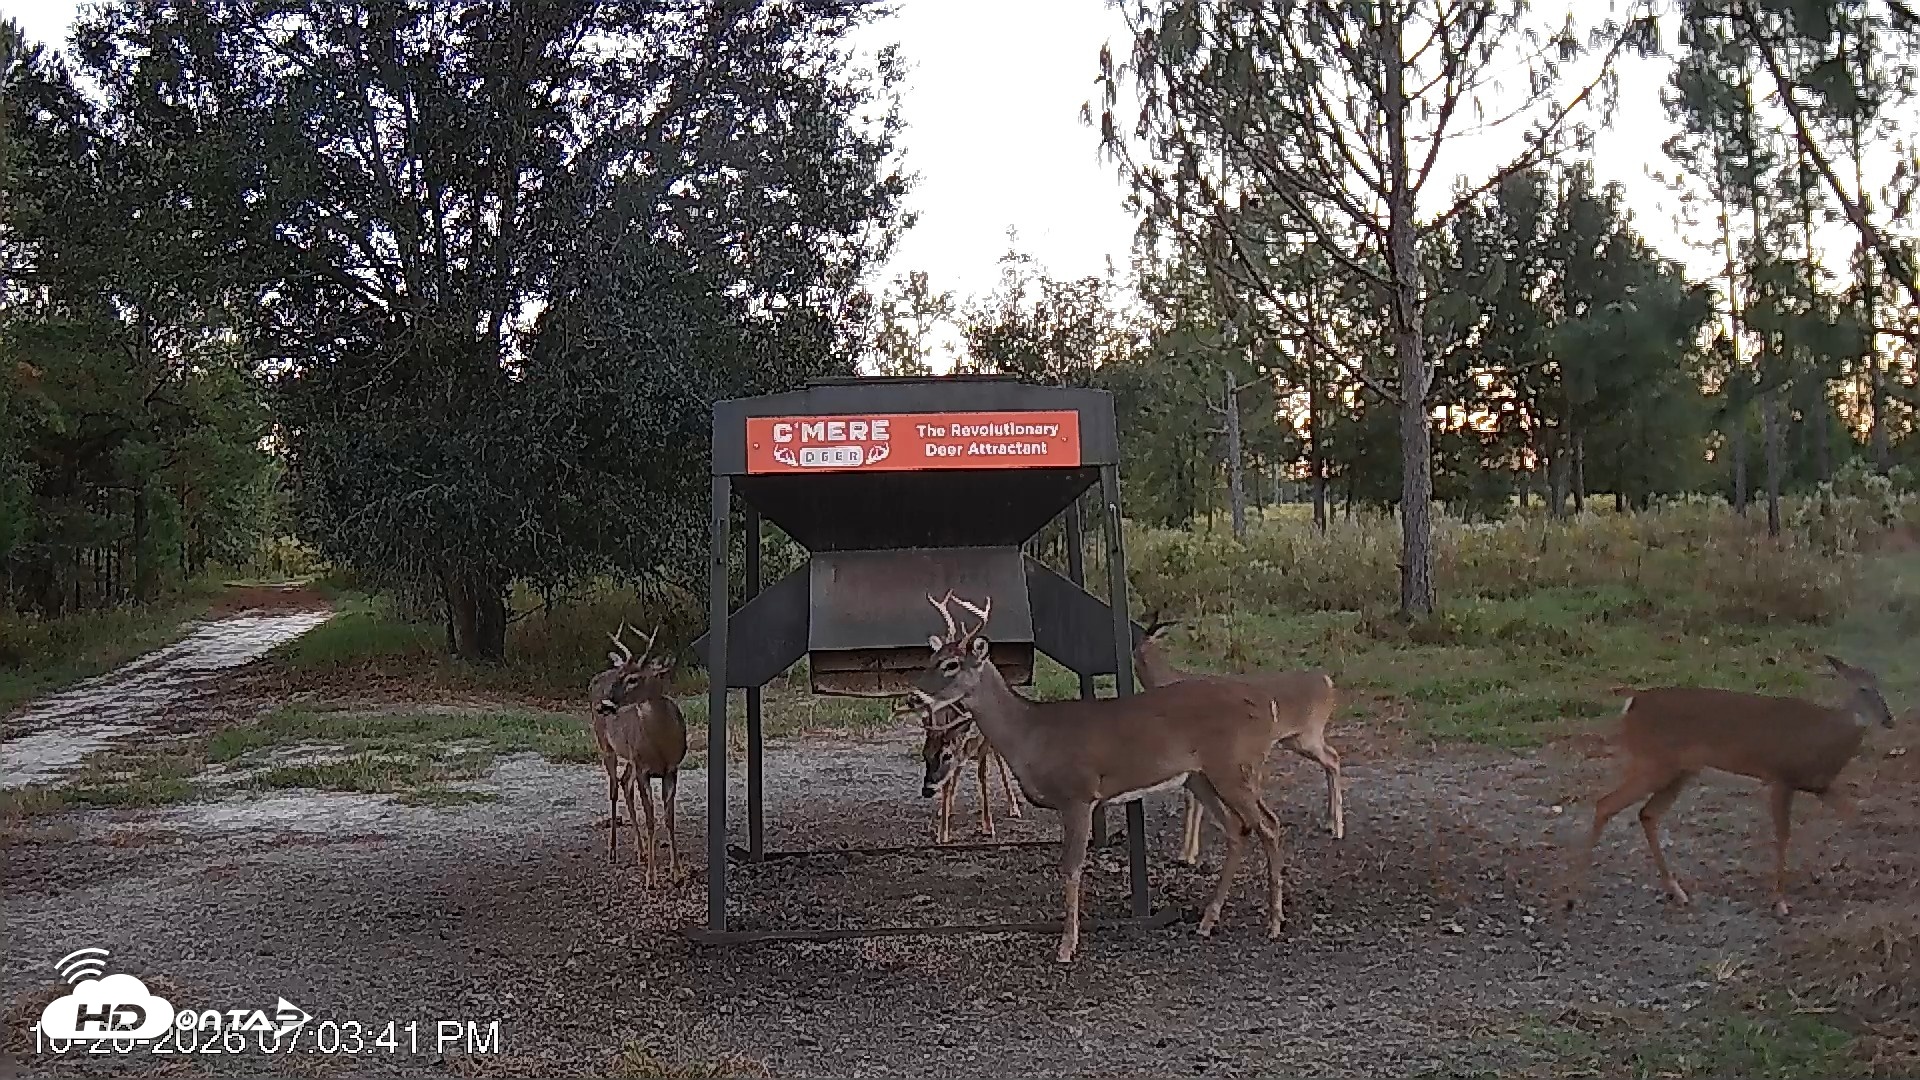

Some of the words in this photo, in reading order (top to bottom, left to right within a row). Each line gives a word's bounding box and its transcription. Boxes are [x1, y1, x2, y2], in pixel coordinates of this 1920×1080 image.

[773, 419, 890, 443] C'MERE
[916, 424, 946, 438] The
[951, 421, 1060, 438] Revolutionary
[804, 449, 859, 463] DEER
[925, 443, 964, 457] Deer
[967, 441, 1048, 456] Attractant
